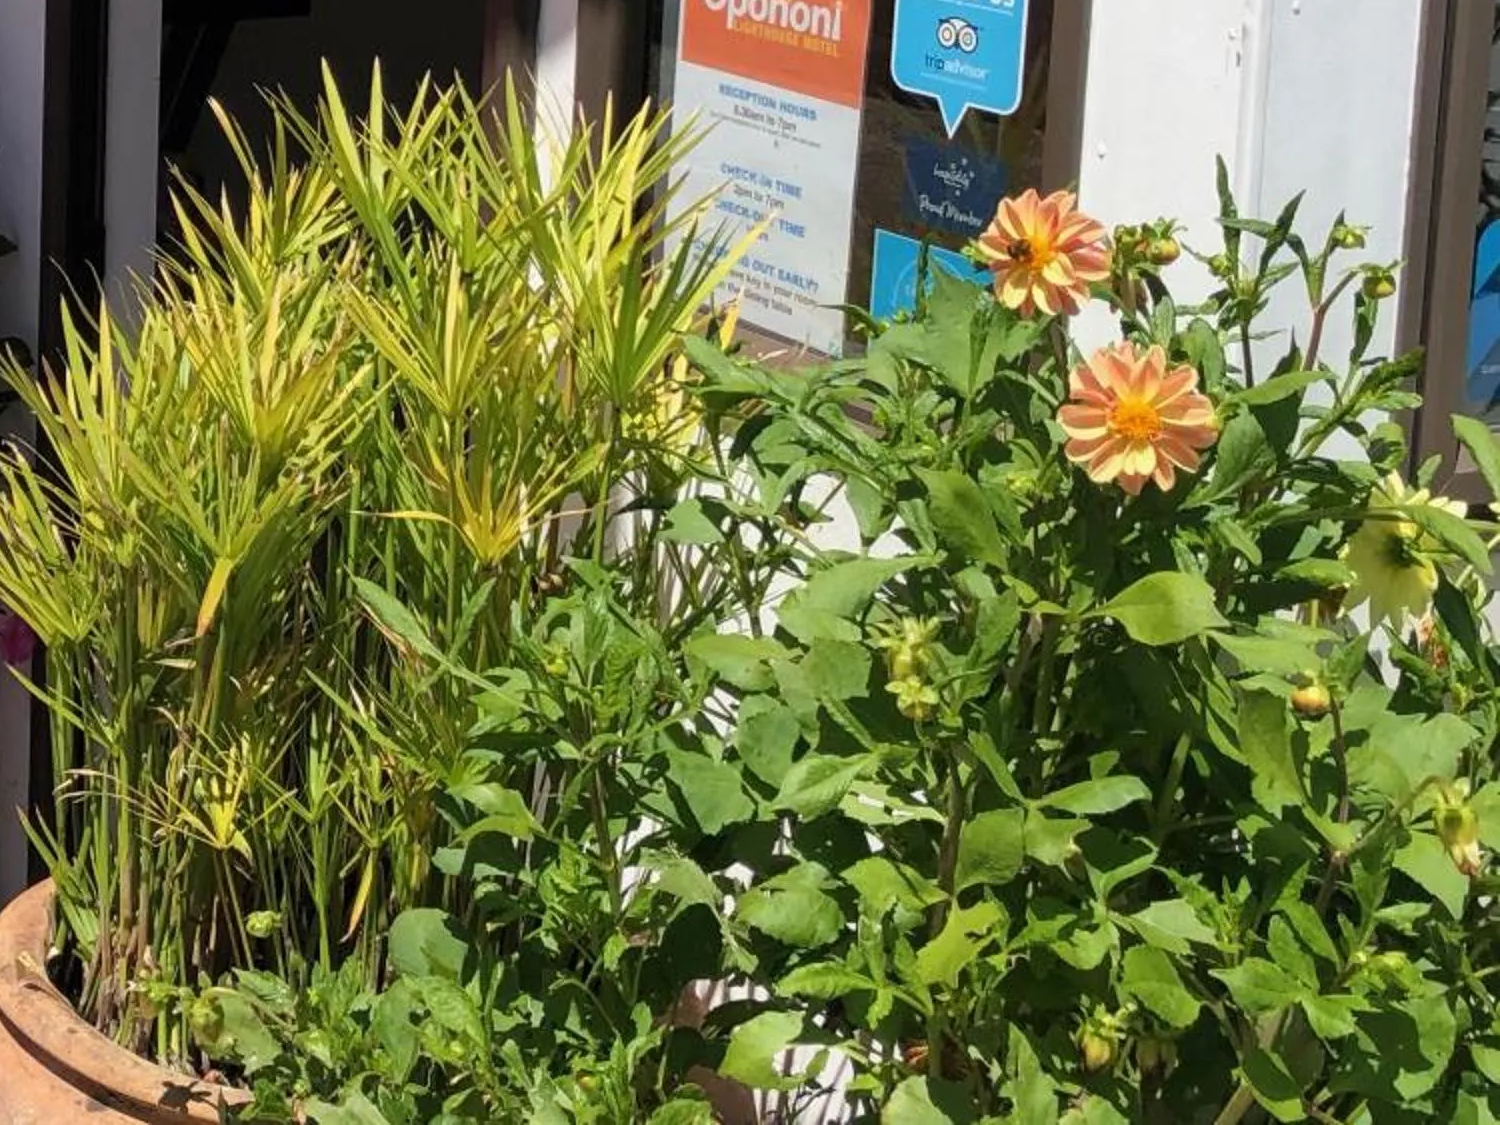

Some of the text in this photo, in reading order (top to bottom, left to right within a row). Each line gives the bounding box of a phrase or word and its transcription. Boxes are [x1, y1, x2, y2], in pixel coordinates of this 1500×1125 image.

[925, 53, 989, 80] tripadvisor
[718, 83, 818, 121] RECEPTION HOURS
[775, 178, 803, 200] TIME
[779, 218, 805, 238] TIME
[751, 259, 775, 276] OUT
